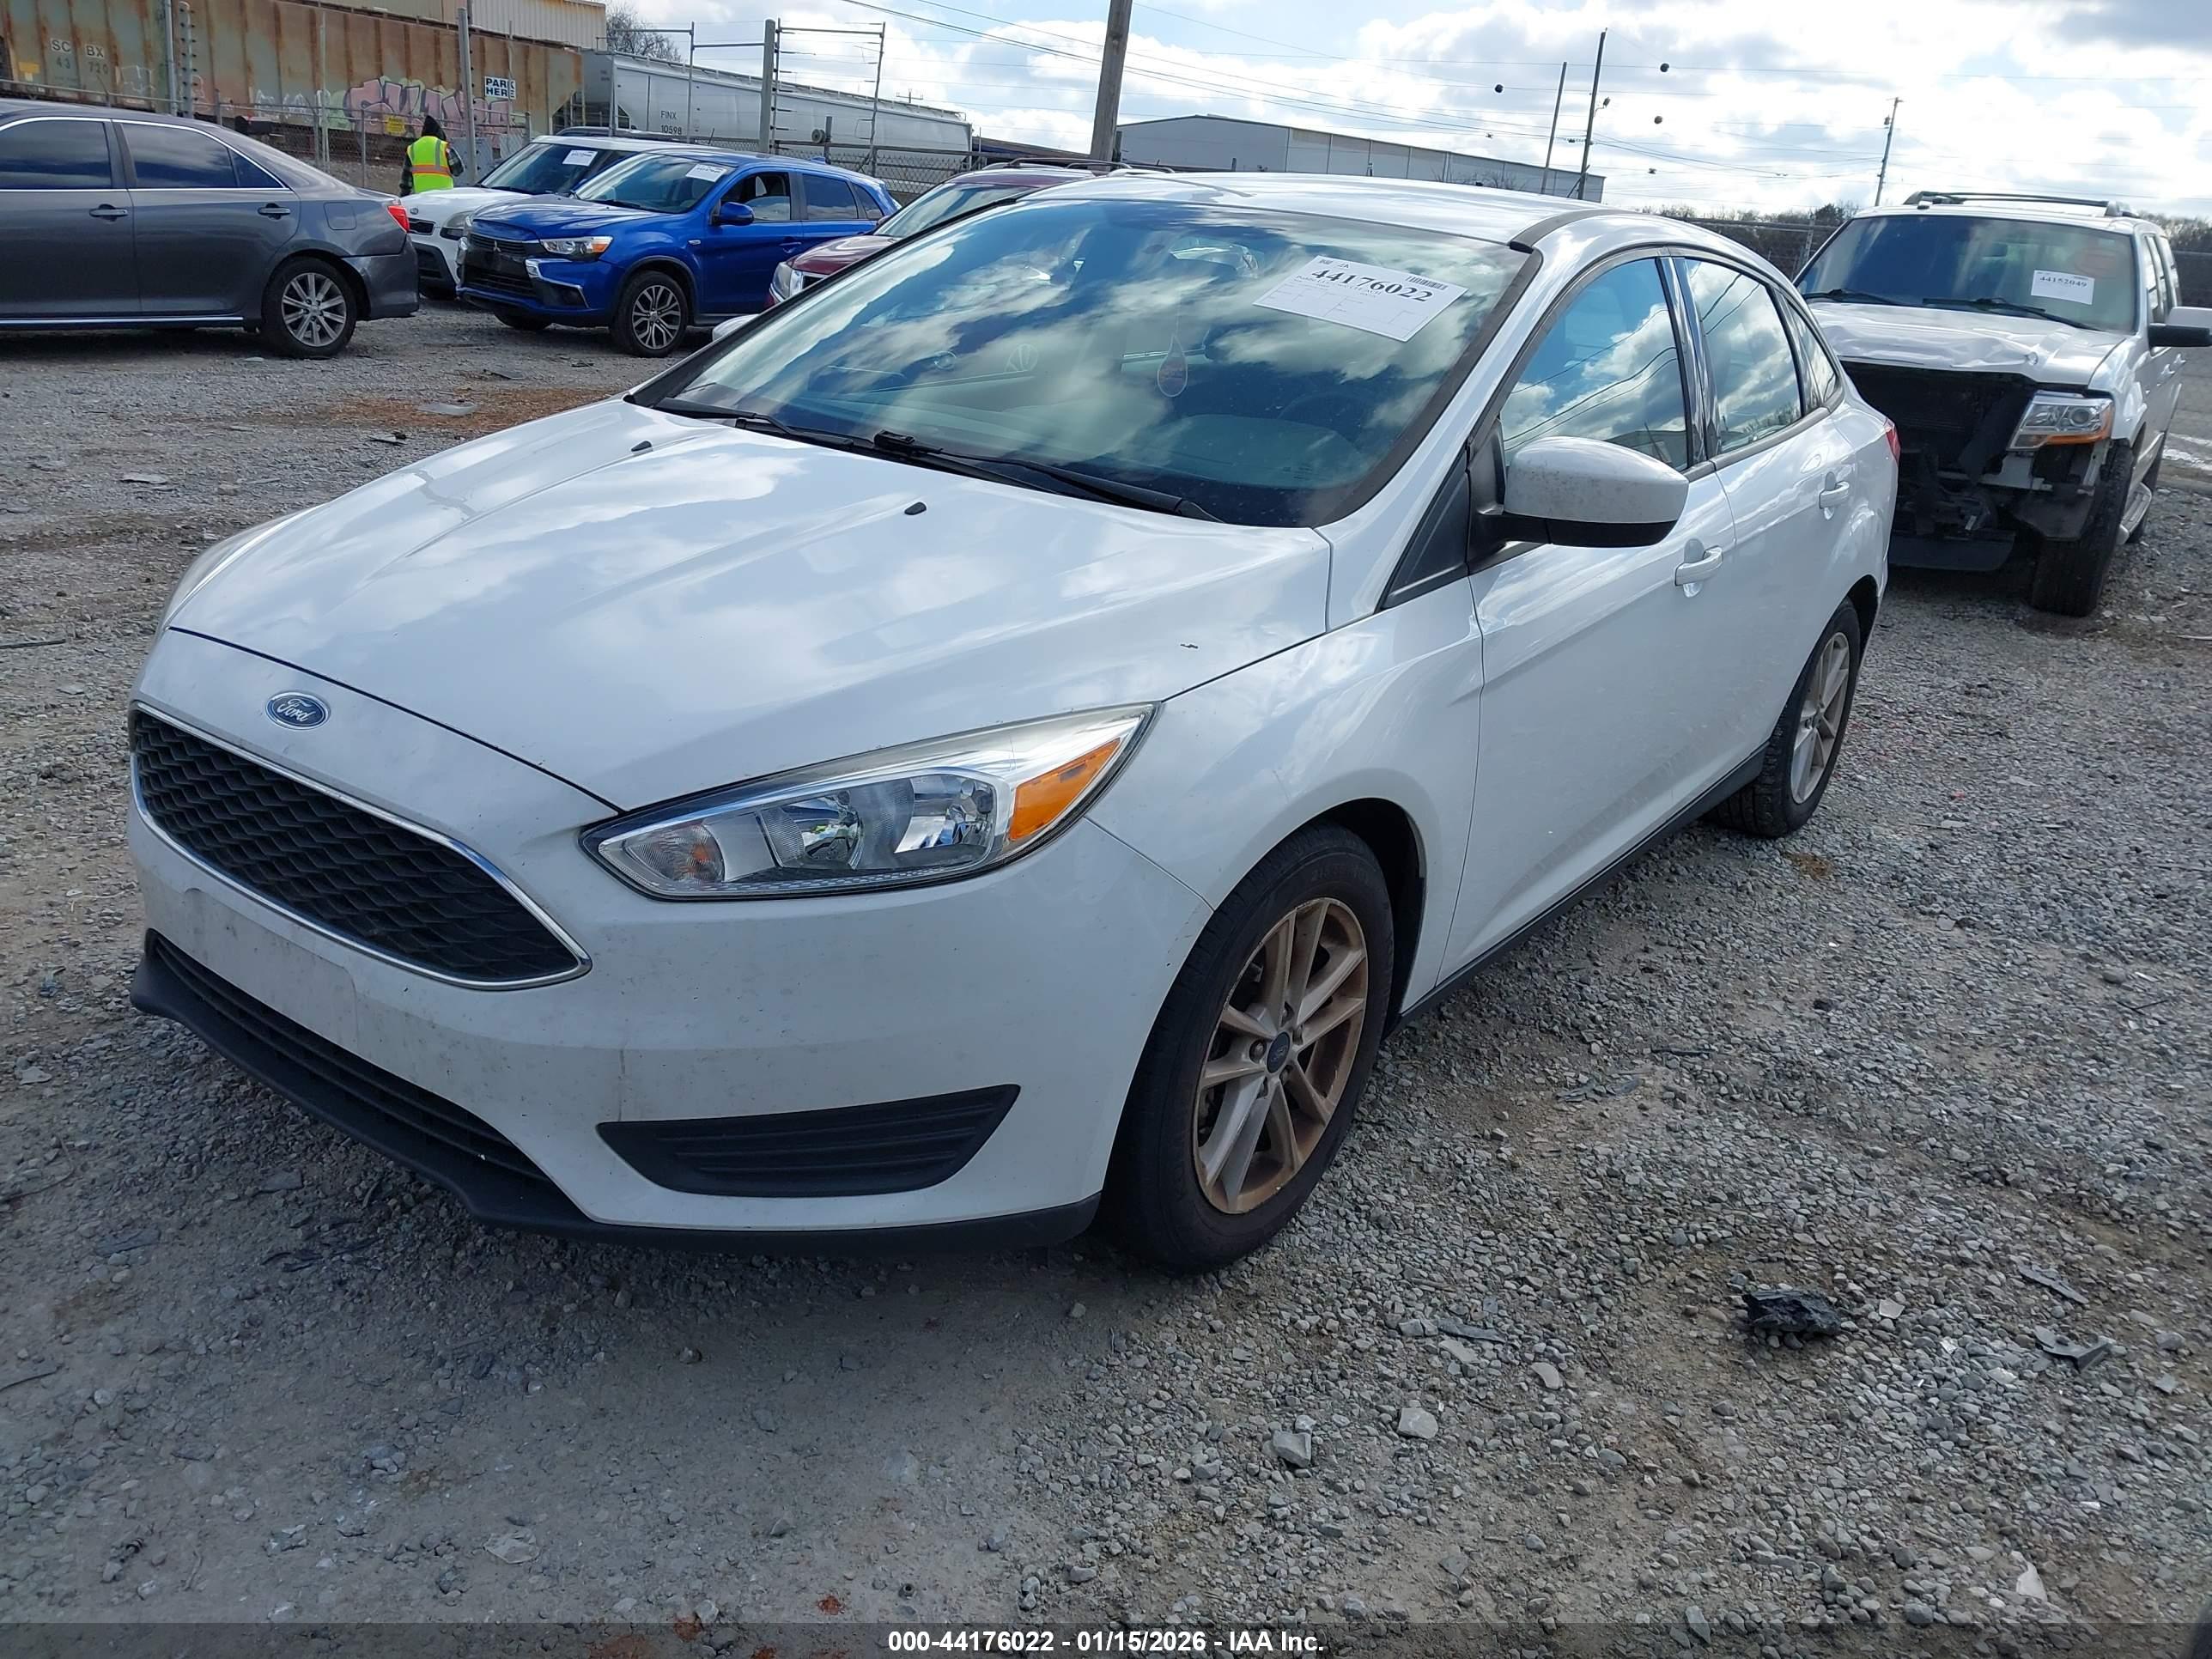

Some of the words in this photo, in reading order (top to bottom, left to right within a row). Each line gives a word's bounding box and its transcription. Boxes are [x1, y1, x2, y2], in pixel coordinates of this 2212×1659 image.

[52, 39, 71, 52] SC
[86, 45, 104, 58] BX
[486, 78, 514, 89] PARK
[486, 87, 514, 98] HERE
[660, 110, 677, 120] FINX
[660, 125, 682, 135] 10598
[1312, 269, 1434, 302] 44176022
[276, 698, 317, 722] Ford
